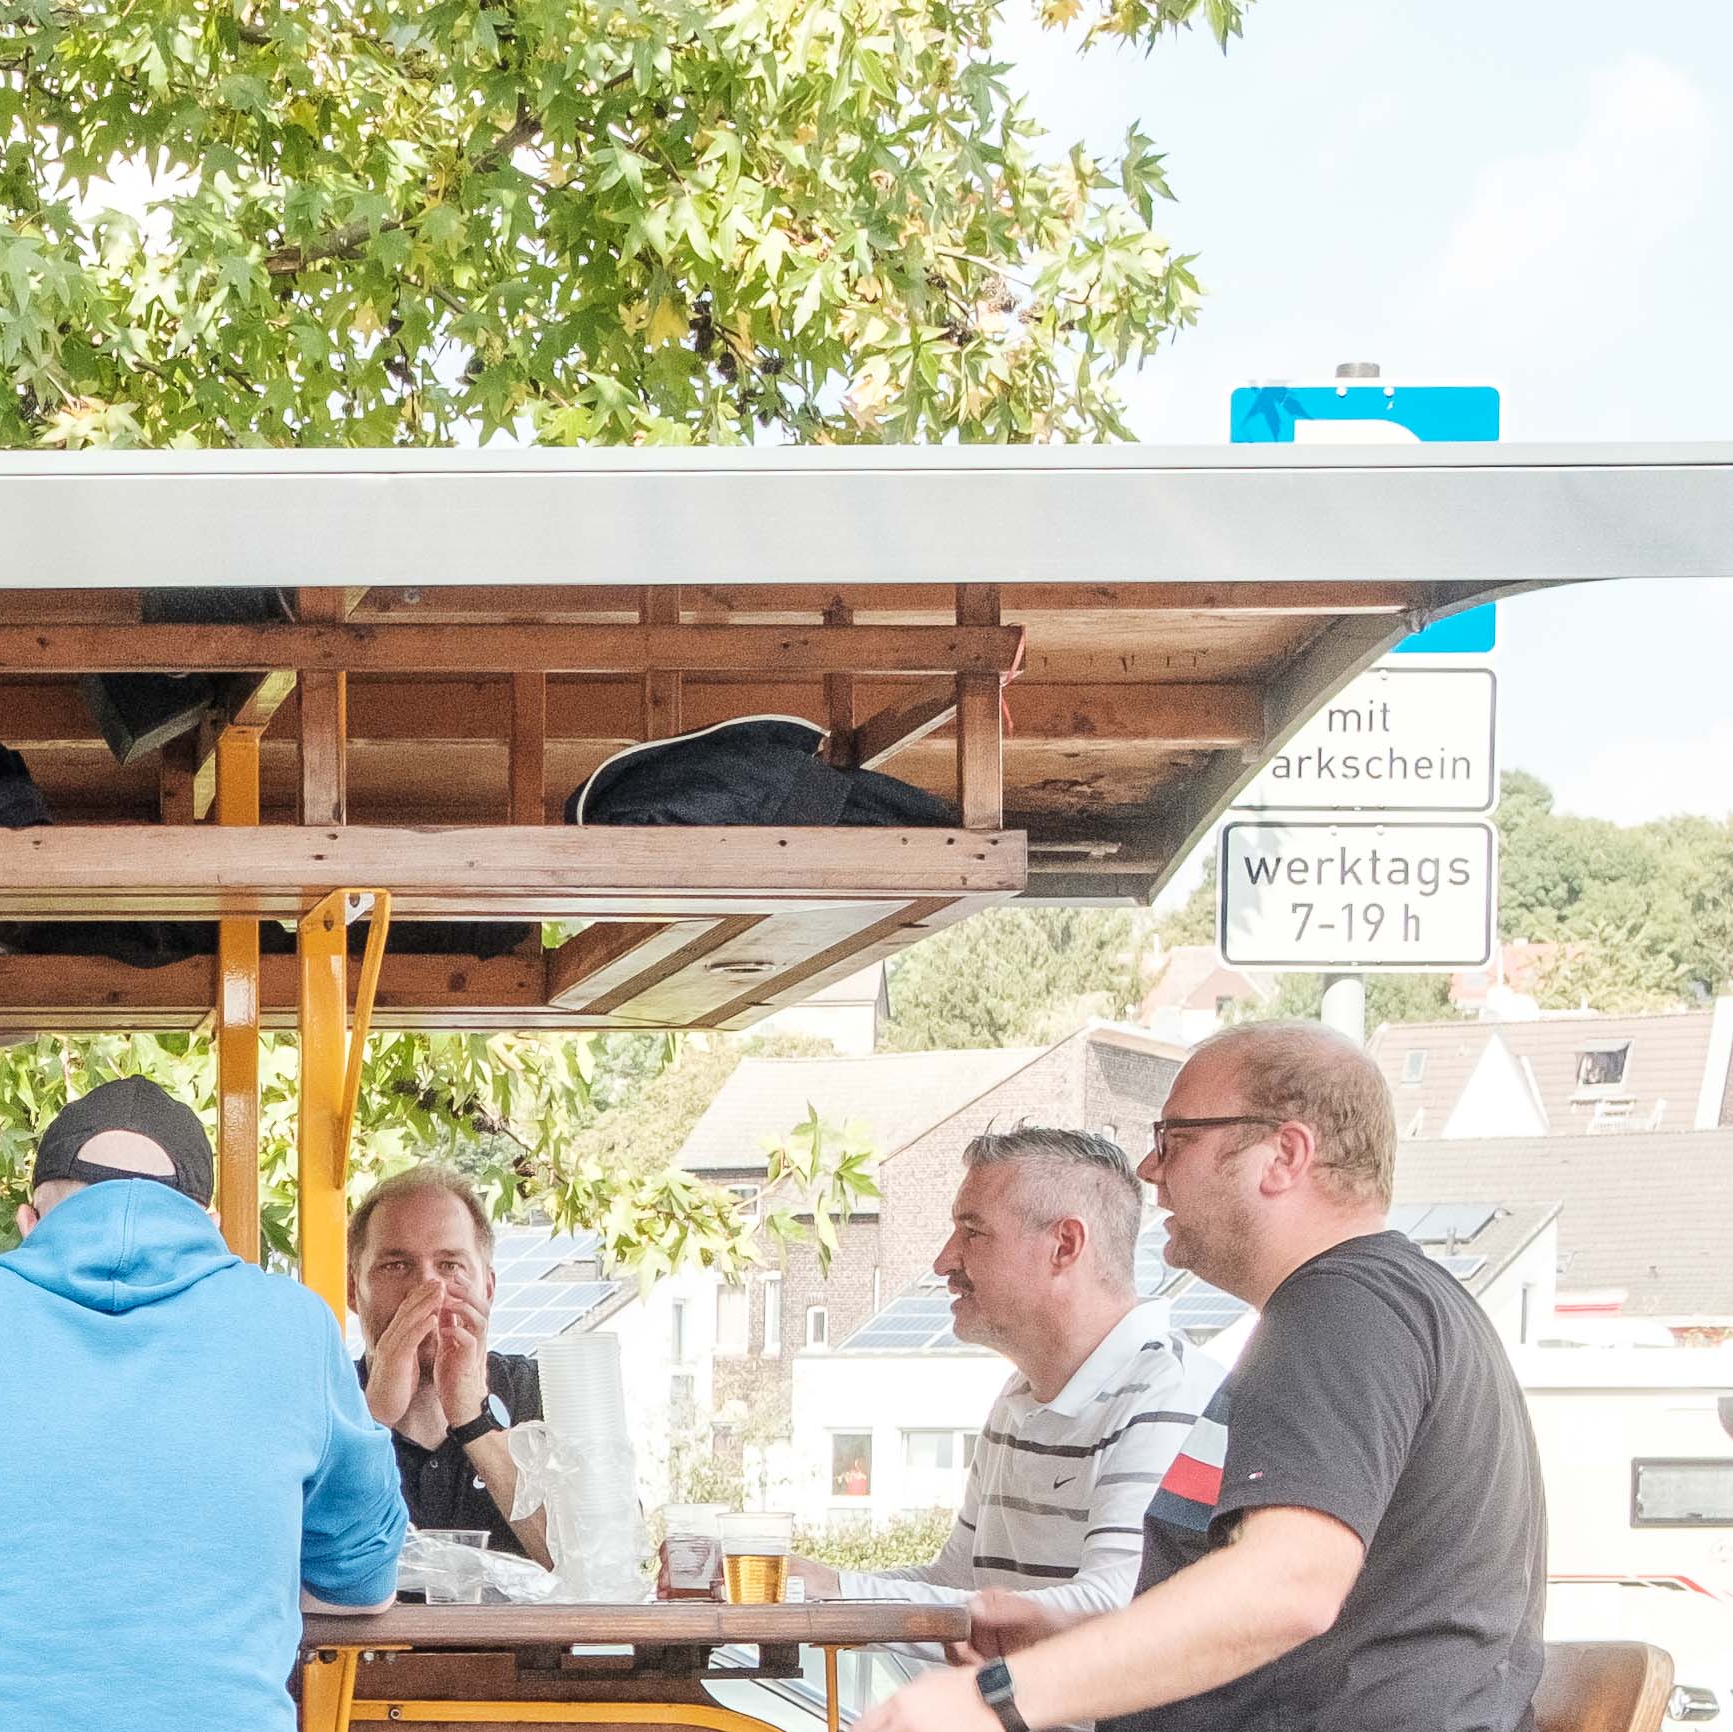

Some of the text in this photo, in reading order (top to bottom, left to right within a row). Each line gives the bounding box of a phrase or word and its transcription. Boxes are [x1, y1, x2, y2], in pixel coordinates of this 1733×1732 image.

[1327, 702, 1390, 732] mit
[1271, 744, 1470, 779] arkschein
[1244, 847, 1469, 896] werktags
[1292, 903, 1419, 941] 7-19 h
